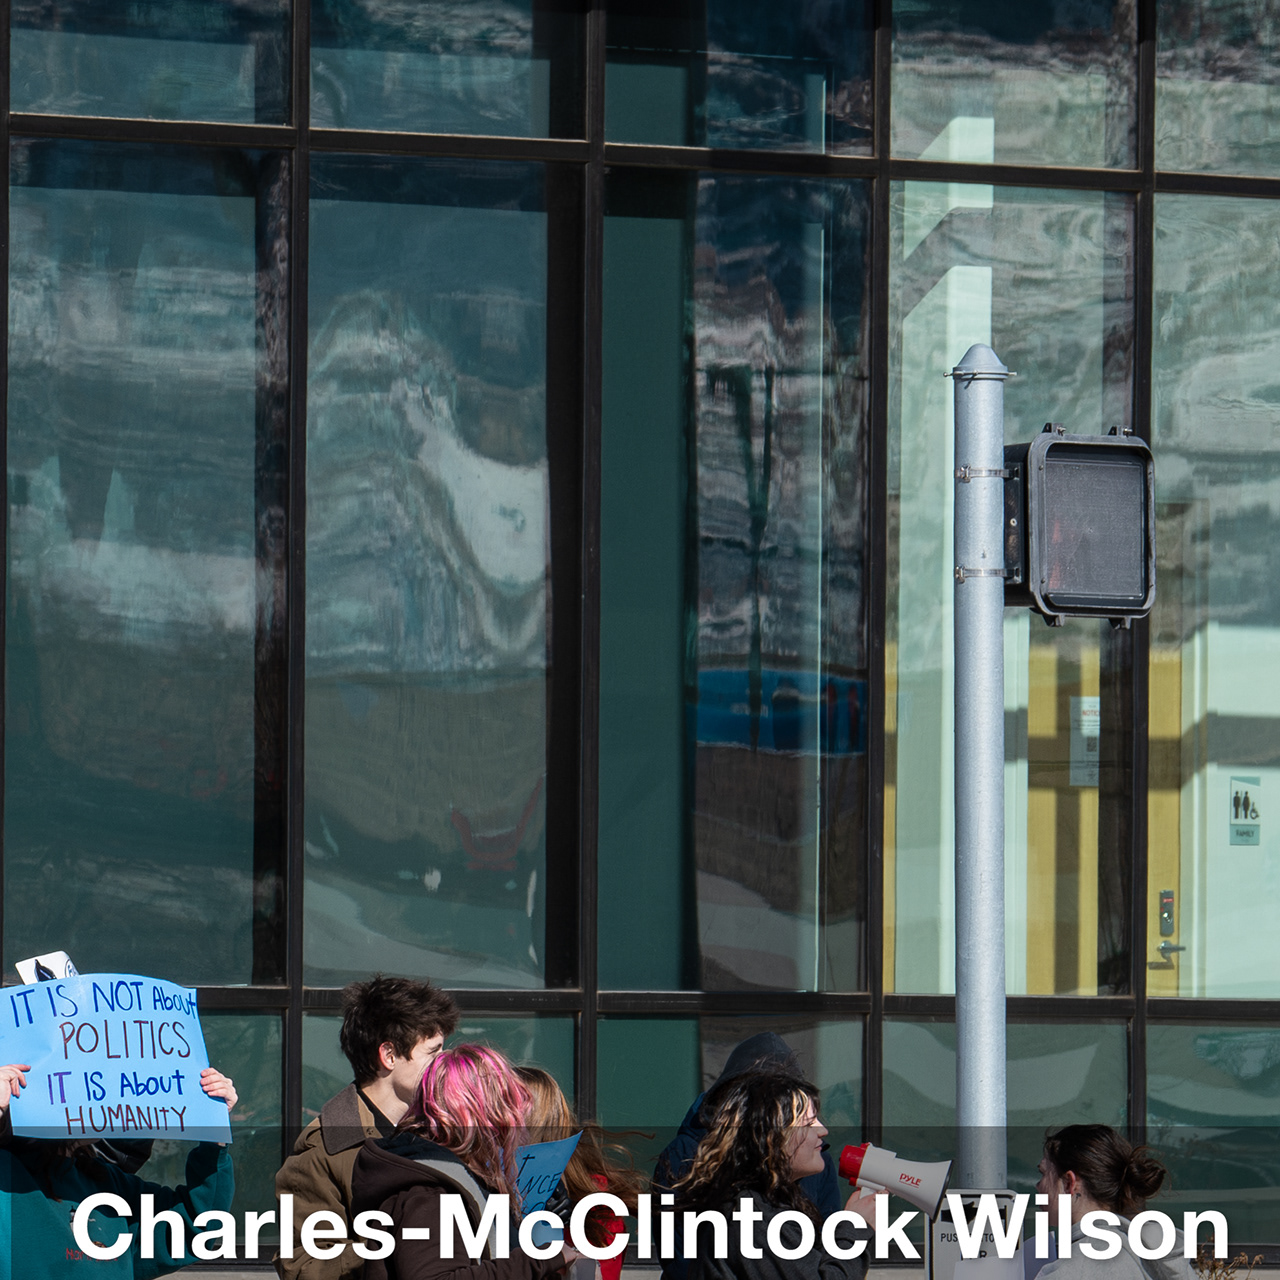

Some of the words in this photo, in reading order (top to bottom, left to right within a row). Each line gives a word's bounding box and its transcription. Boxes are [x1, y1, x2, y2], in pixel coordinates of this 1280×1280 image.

[10, 988, 35, 1028] IT
[47, 985, 79, 1018] IS
[92, 981, 143, 1013] NOT
[59, 1020, 190, 1060] POLITICS
[48, 1071, 72, 1105] IT
[84, 1071, 106, 1102] IS
